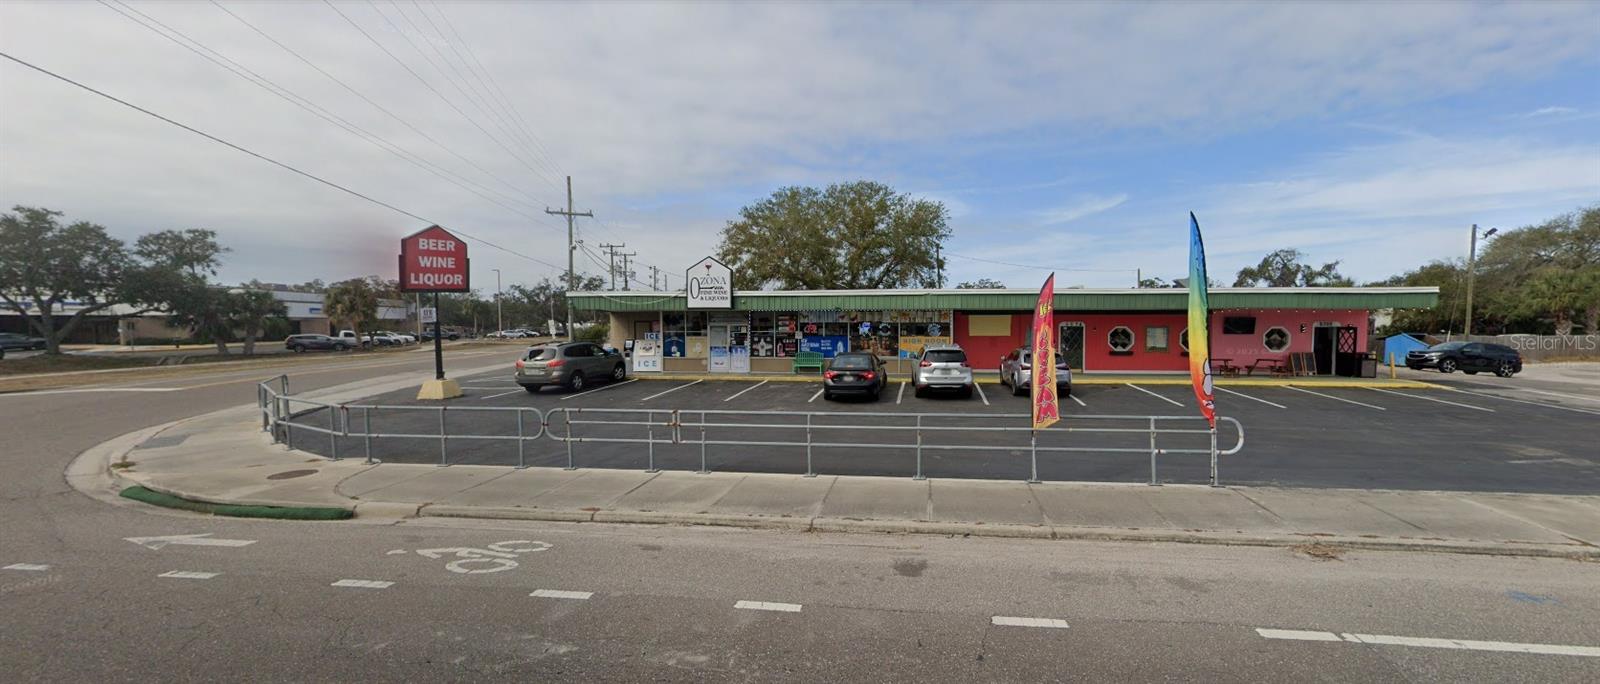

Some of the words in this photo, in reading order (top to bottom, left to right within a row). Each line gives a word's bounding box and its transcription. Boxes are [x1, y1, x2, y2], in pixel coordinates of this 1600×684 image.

[418, 238, 456, 252] BEER
[418, 256, 456, 269] WINE
[410, 272, 463, 287] LIQUOR
[690, 276, 727, 300] OZONA
[637, 360, 658, 368] ICE
